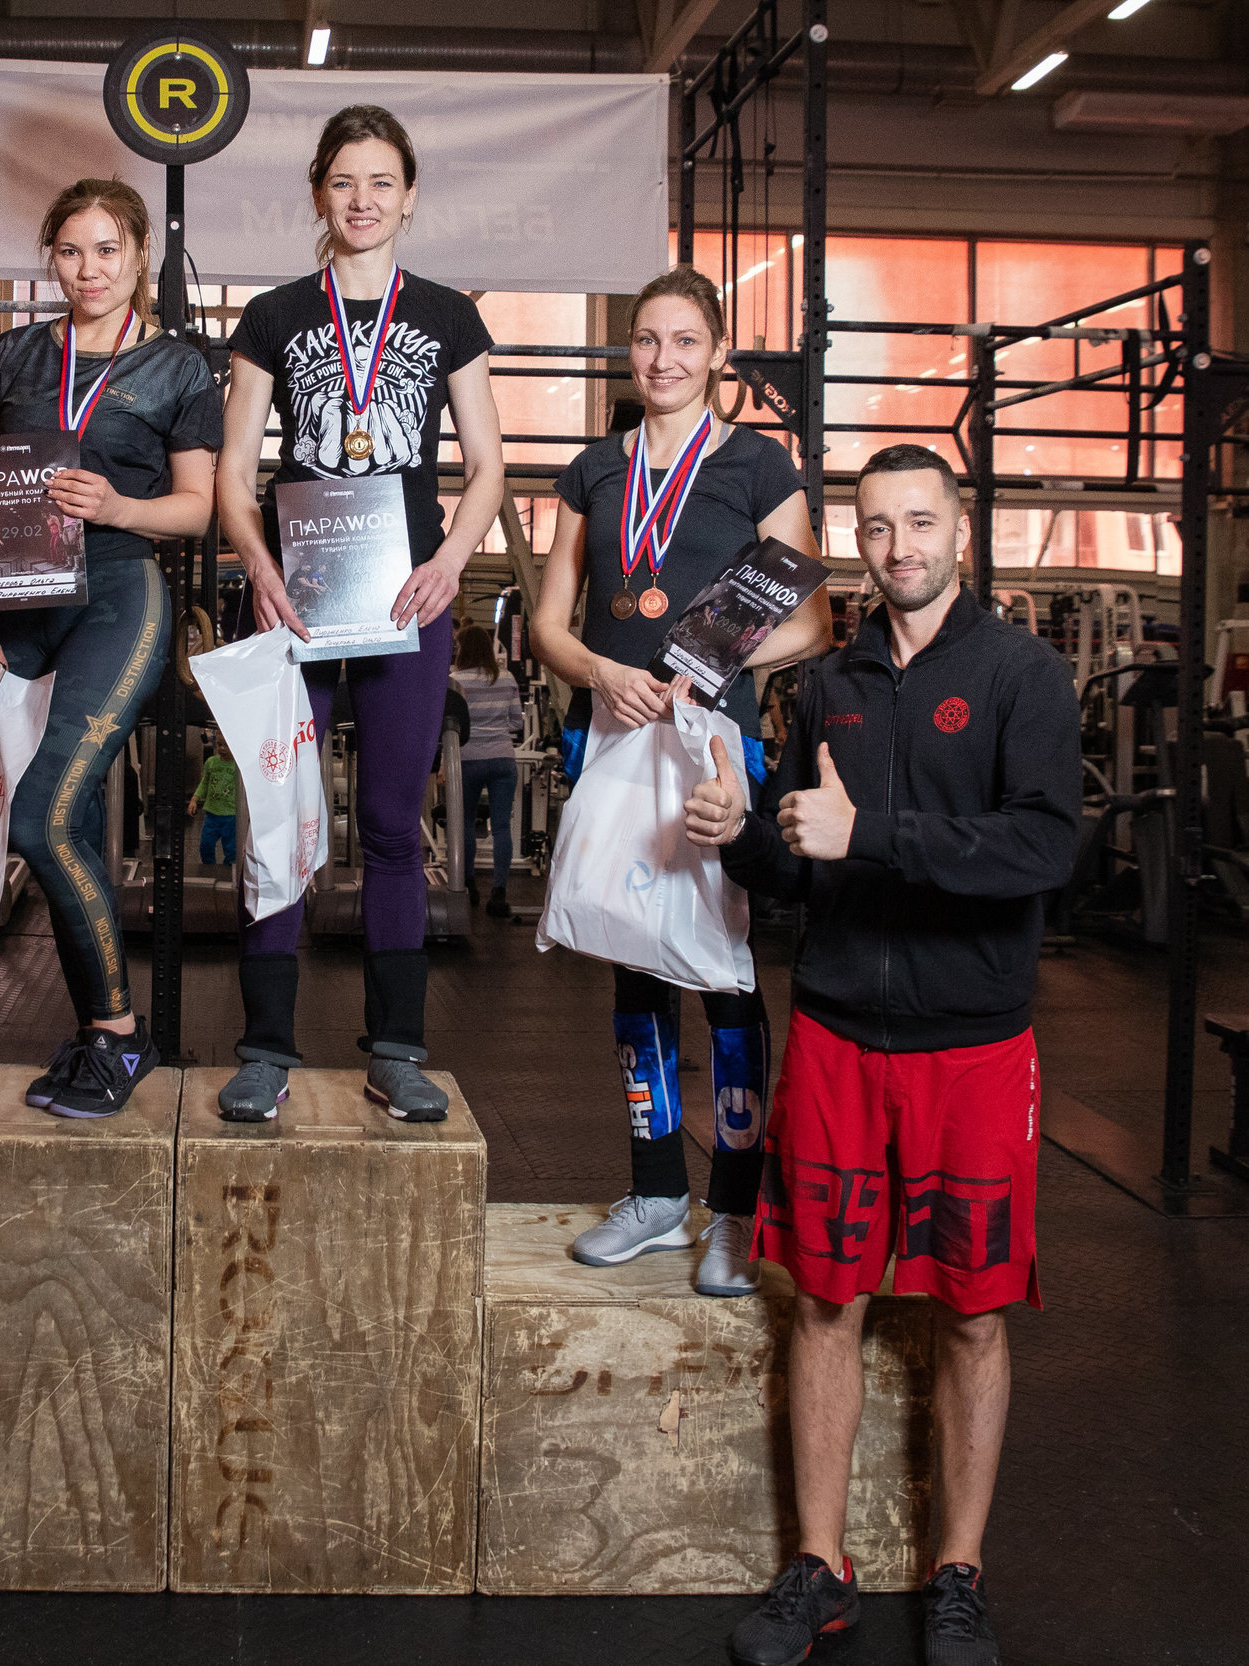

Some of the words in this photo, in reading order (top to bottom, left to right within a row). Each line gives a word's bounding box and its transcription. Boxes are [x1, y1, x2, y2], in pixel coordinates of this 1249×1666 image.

[158, 77, 198, 109] R
[300, 375, 318, 389] THE
[316, 361, 343, 376] POWE
[387, 363, 407, 378] ONE
[21, 497, 32, 505] ПО
[1, 524, 43, 539] 29.02
[289, 512, 395, 537] ПАРАWOD
[735, 564, 798, 606] ПАРАWOD
[715, 615, 742, 637] 29.02
[116, 622, 156, 698] DISTINCTION
[53, 759, 88, 826] DISTINCTION
[56, 843, 98, 902] DISTINCTION
[95, 916, 118, 975] DISTINCTION
